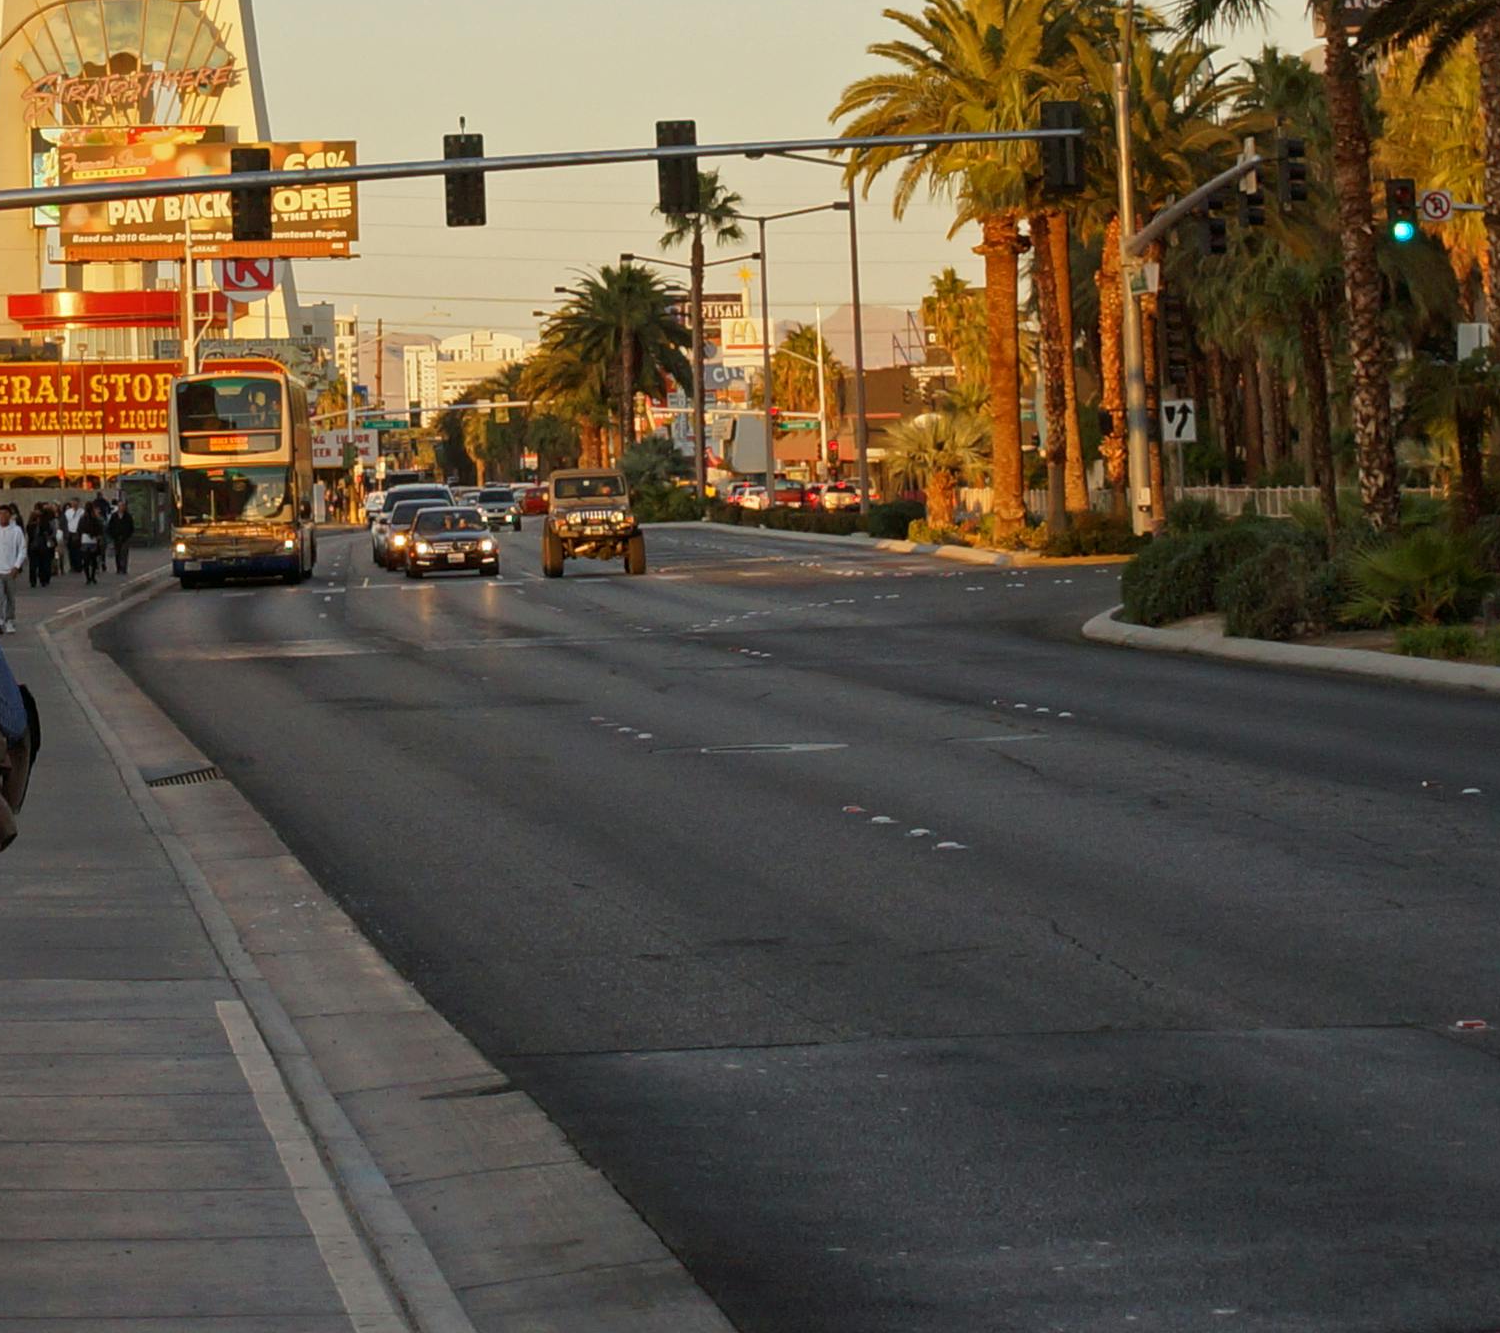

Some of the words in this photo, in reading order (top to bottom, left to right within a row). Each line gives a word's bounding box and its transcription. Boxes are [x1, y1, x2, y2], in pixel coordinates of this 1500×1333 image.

[108, 198, 157, 225] PAY
[272, 186, 352, 213] ORE
[281, 210, 309, 222] THE
[311, 209, 352, 220] STRIP
[90, 373, 173, 404] STOR
[30, 411, 103, 430] MARKET
[120, 409, 168, 429] LIQUO
[143, 454, 169, 463] CAND
